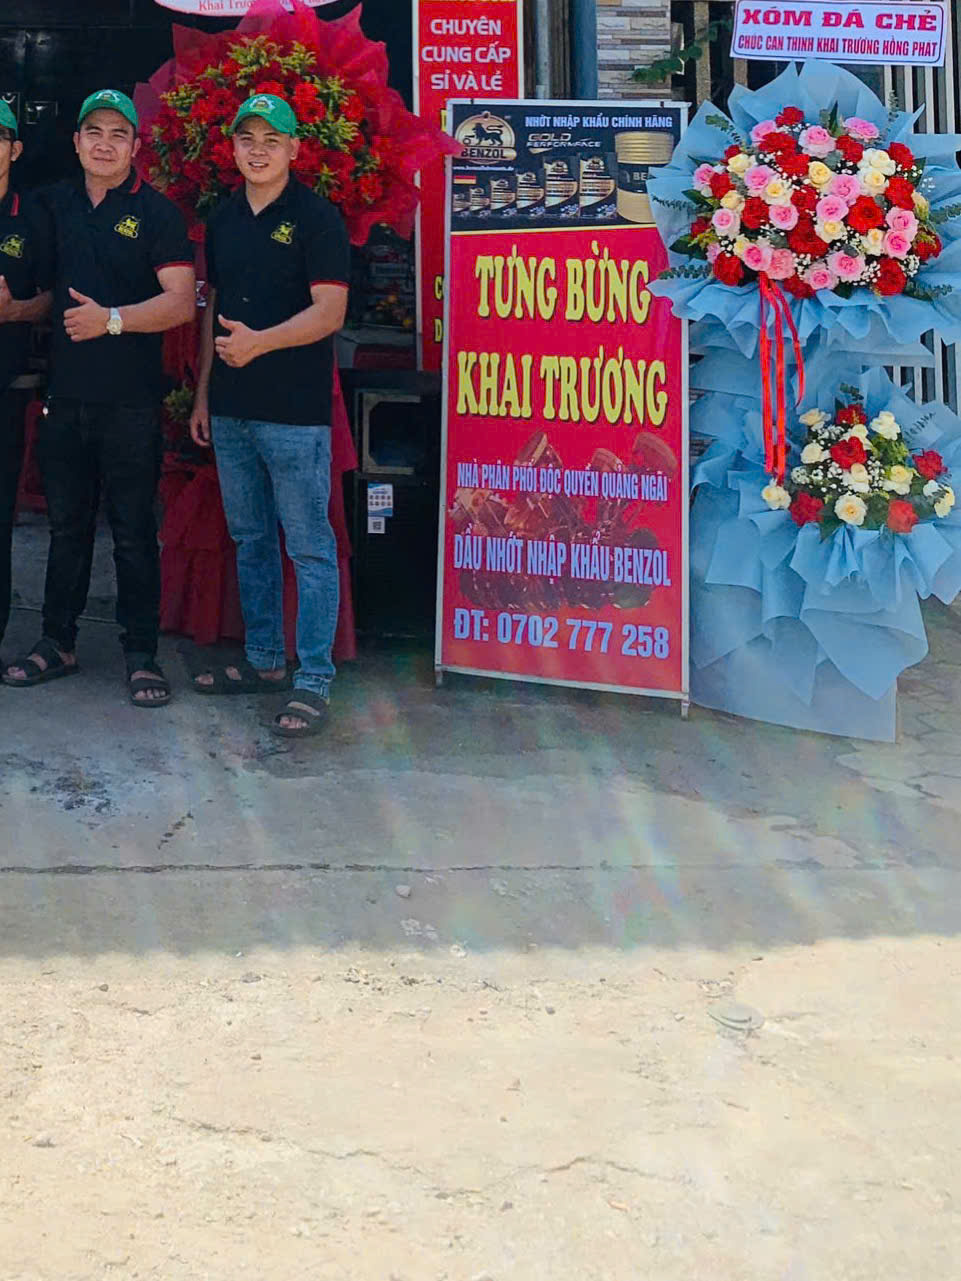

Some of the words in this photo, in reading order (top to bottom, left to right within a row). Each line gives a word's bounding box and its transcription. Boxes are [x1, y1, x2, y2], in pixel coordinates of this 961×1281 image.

[431, 16, 501, 35] CHUYÊN
[742, 6, 812, 26] XÓM
[822, 8, 864, 28] ĐÁ
[875, 9, 937, 31] CHẺ
[422, 46, 472, 62] CUNG
[475, 41, 511, 63] CẤP
[817, 37, 839, 53] KHAI
[453, 70, 478, 90] VÀ
[461, 148, 507, 158] BENZOL
[475, 244, 557, 320] TƯNG
[565, 240, 651, 324] BỪNG
[456, 351, 533, 418] KHAI
[539, 345, 668, 426] TRƯƠNG
[457, 458, 479, 488] NHÀ
[482, 460, 510, 489] PHÂN
[513, 458, 537, 492] PHỐI
[486, 531, 524, 573] NHỚT
[527, 534, 566, 584] NHẬP
[571, 531, 610, 581] KHẨU
[614, 547, 672, 586] BENZOL
[454, 608, 488, 641] ĐT:
[497, 613, 558, 648] 0702
[566, 619, 613, 653] 777
[622, 624, 669, 659] 258
